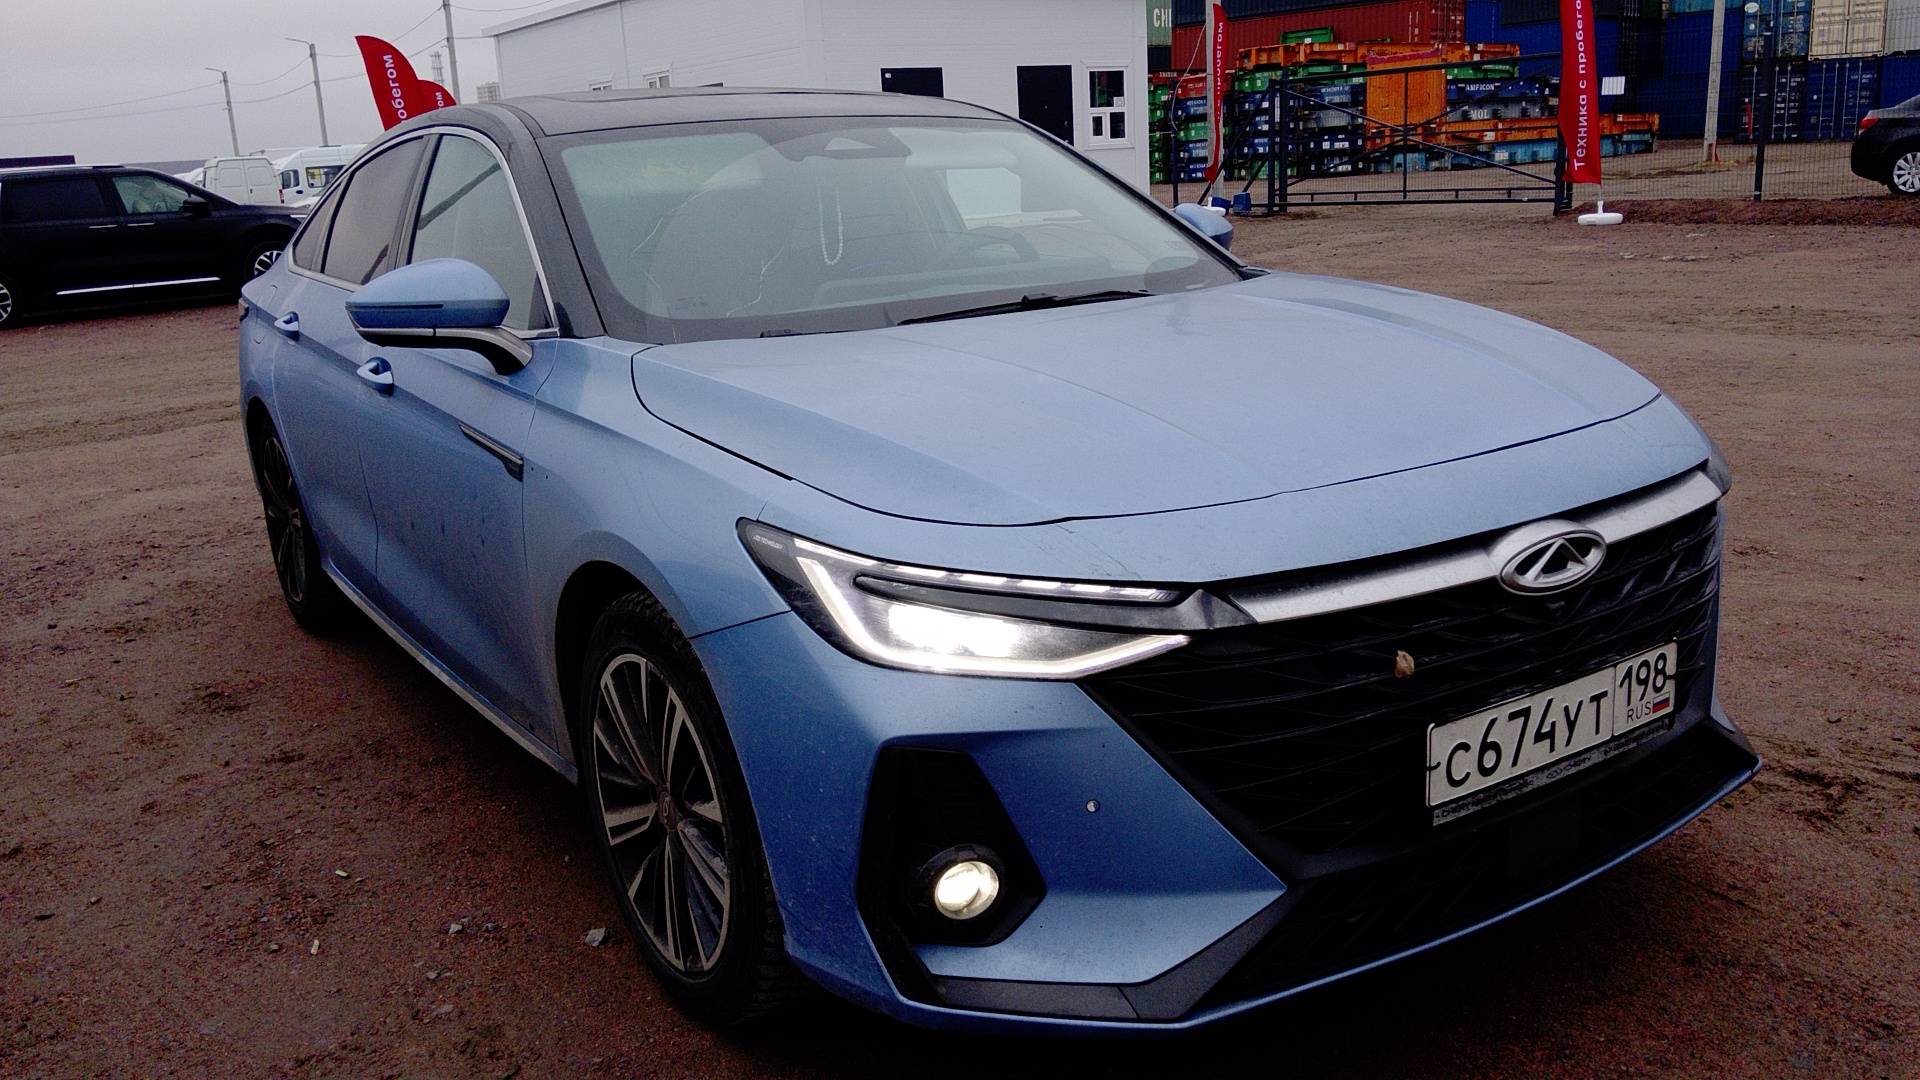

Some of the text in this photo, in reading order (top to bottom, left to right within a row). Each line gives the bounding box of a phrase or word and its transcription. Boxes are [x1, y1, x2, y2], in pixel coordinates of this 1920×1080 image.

[383, 54, 408, 119] обегом
[435, 91, 445, 107] ом
[1579, 79, 1587, 89] с
[1573, 95, 1587, 170] Техника
[1619, 651, 1667, 708] 198
[1626, 700, 1652, 725] RUS
